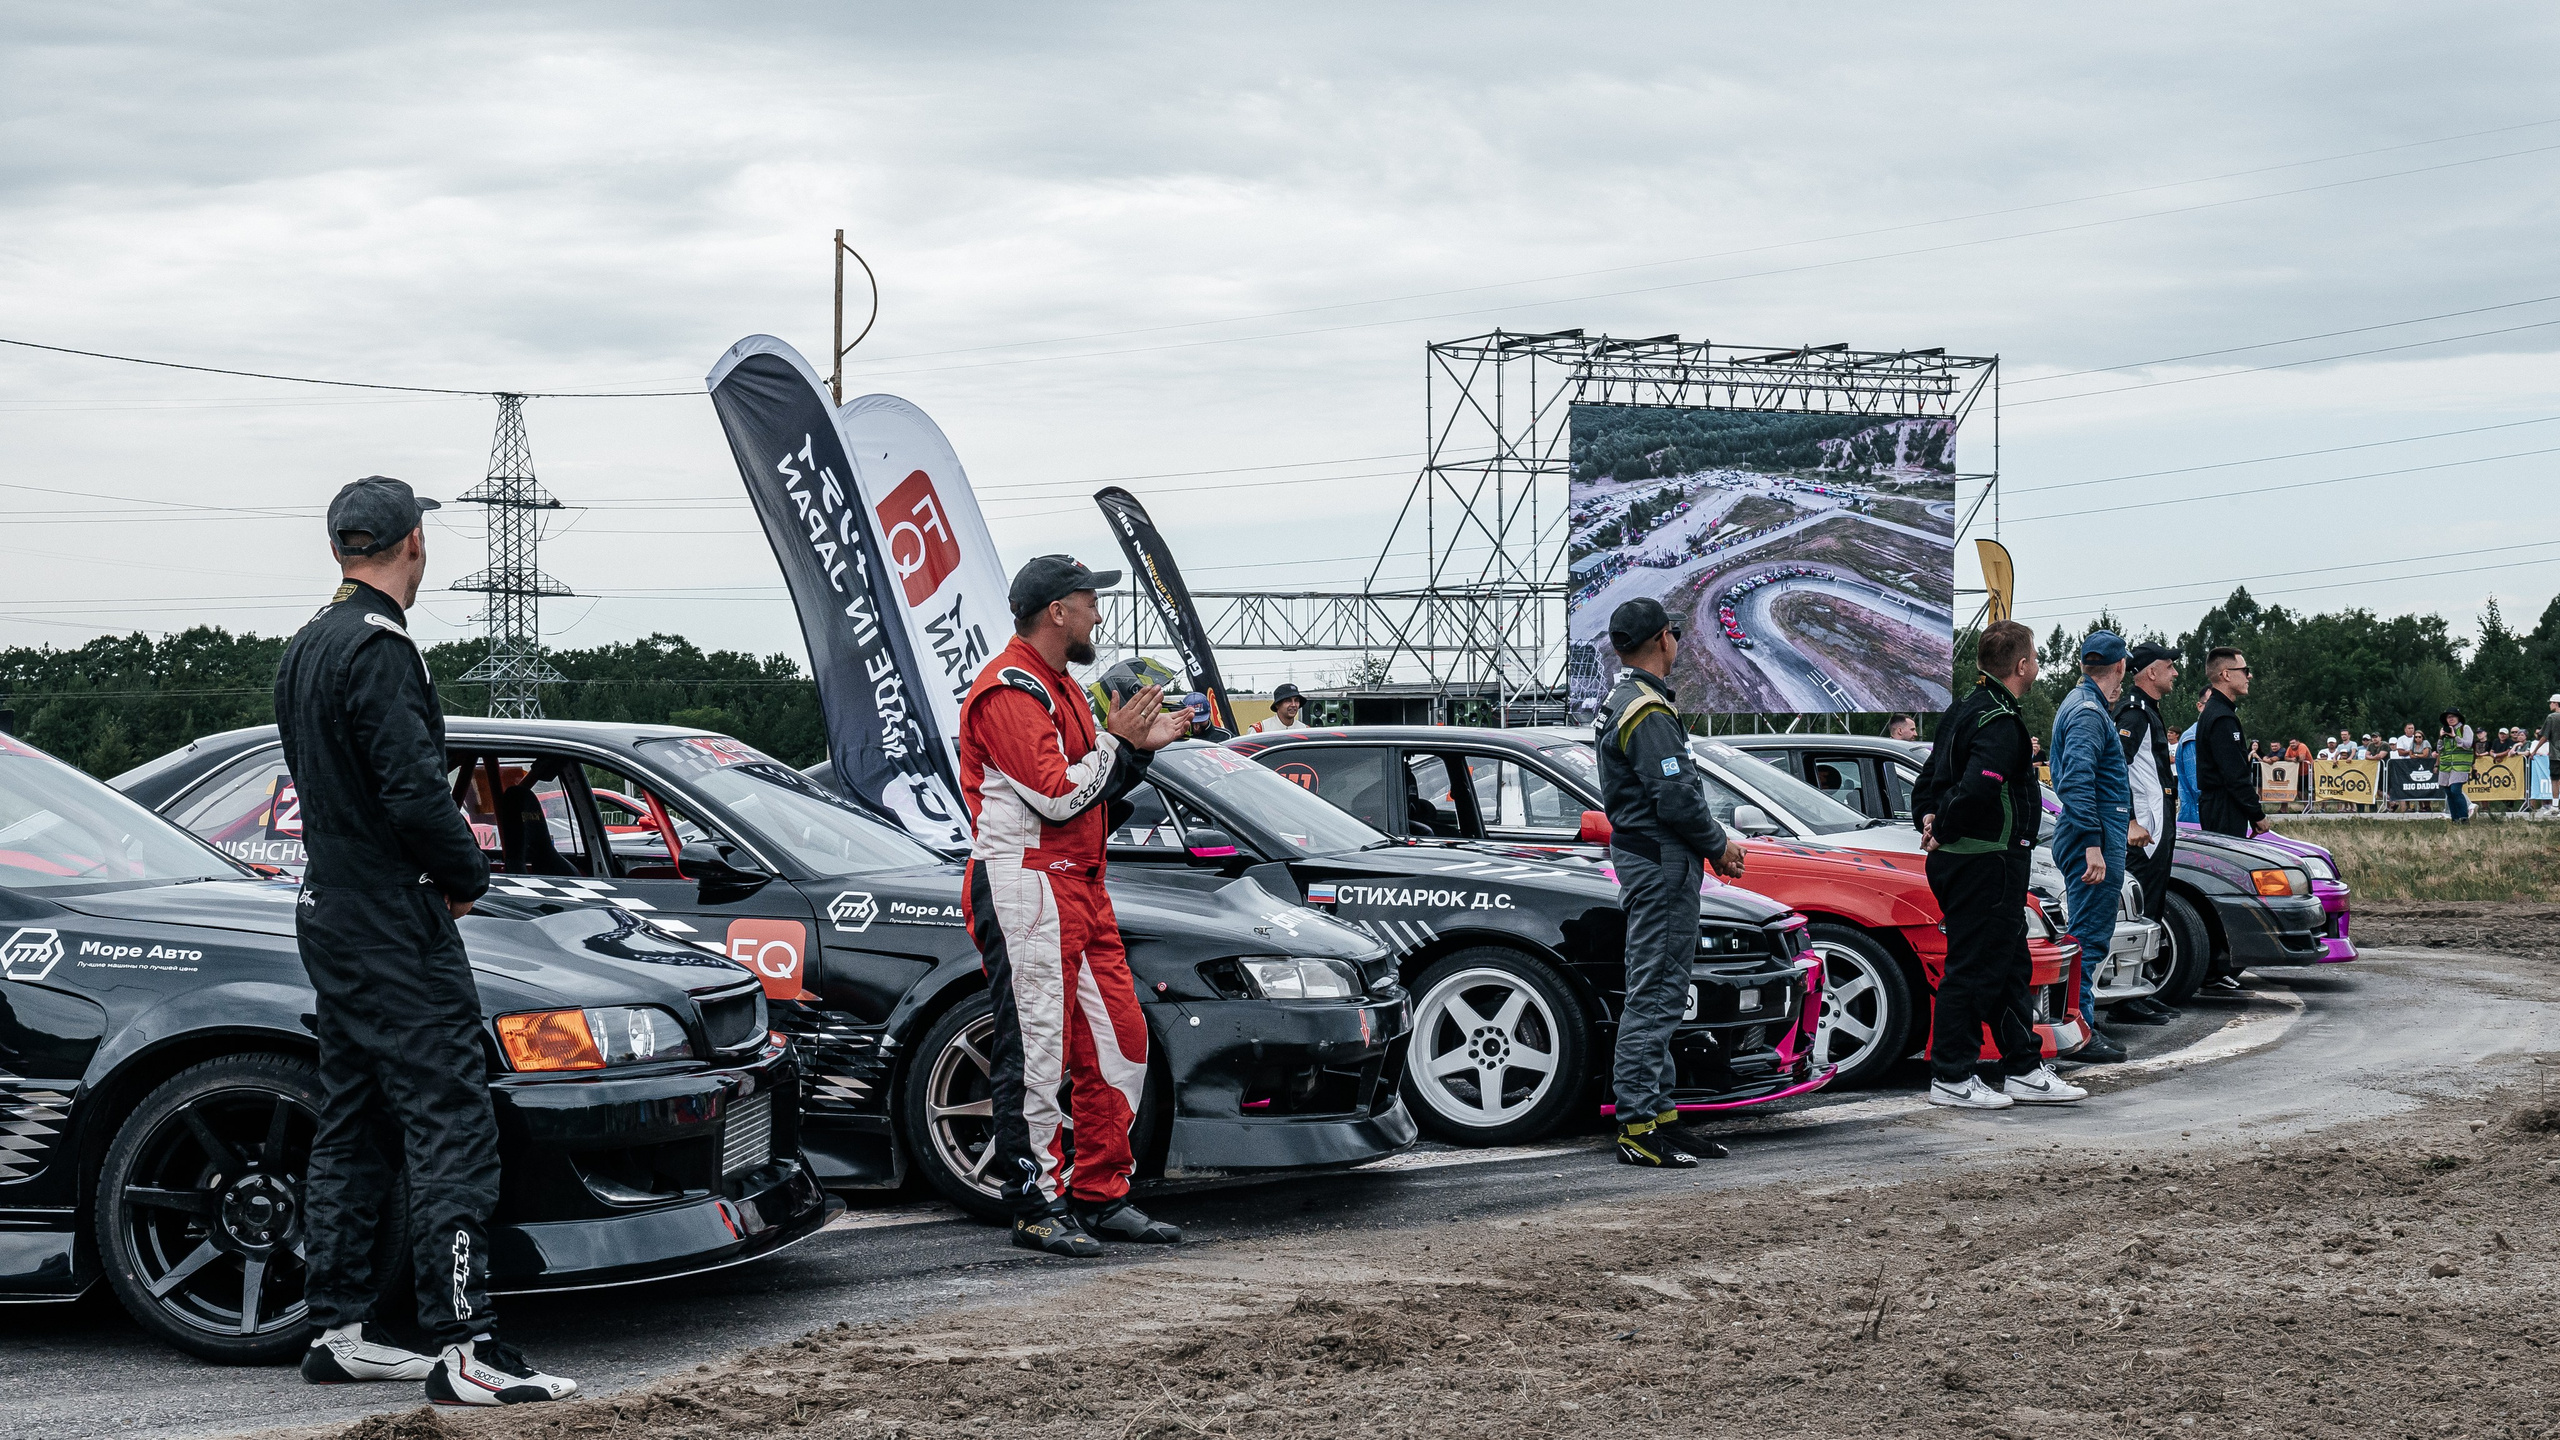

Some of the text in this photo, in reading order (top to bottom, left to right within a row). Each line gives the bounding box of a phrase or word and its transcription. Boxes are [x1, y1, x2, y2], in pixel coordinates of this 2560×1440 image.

[1662, 761, 1679, 773] FQ
[2403, 782, 2440, 791] BIG DADDY
[1337, 885, 1516, 911] СТИХАРЮК Д.С.
[890, 901, 966, 918] Море Ав
[79, 940, 203, 962] Море Авто
[76, 960, 106, 969] Лучшие
[107, 962, 138, 970] машины
[148, 964, 178, 972] лучшей
[474, 1368, 505, 1386] sparco
